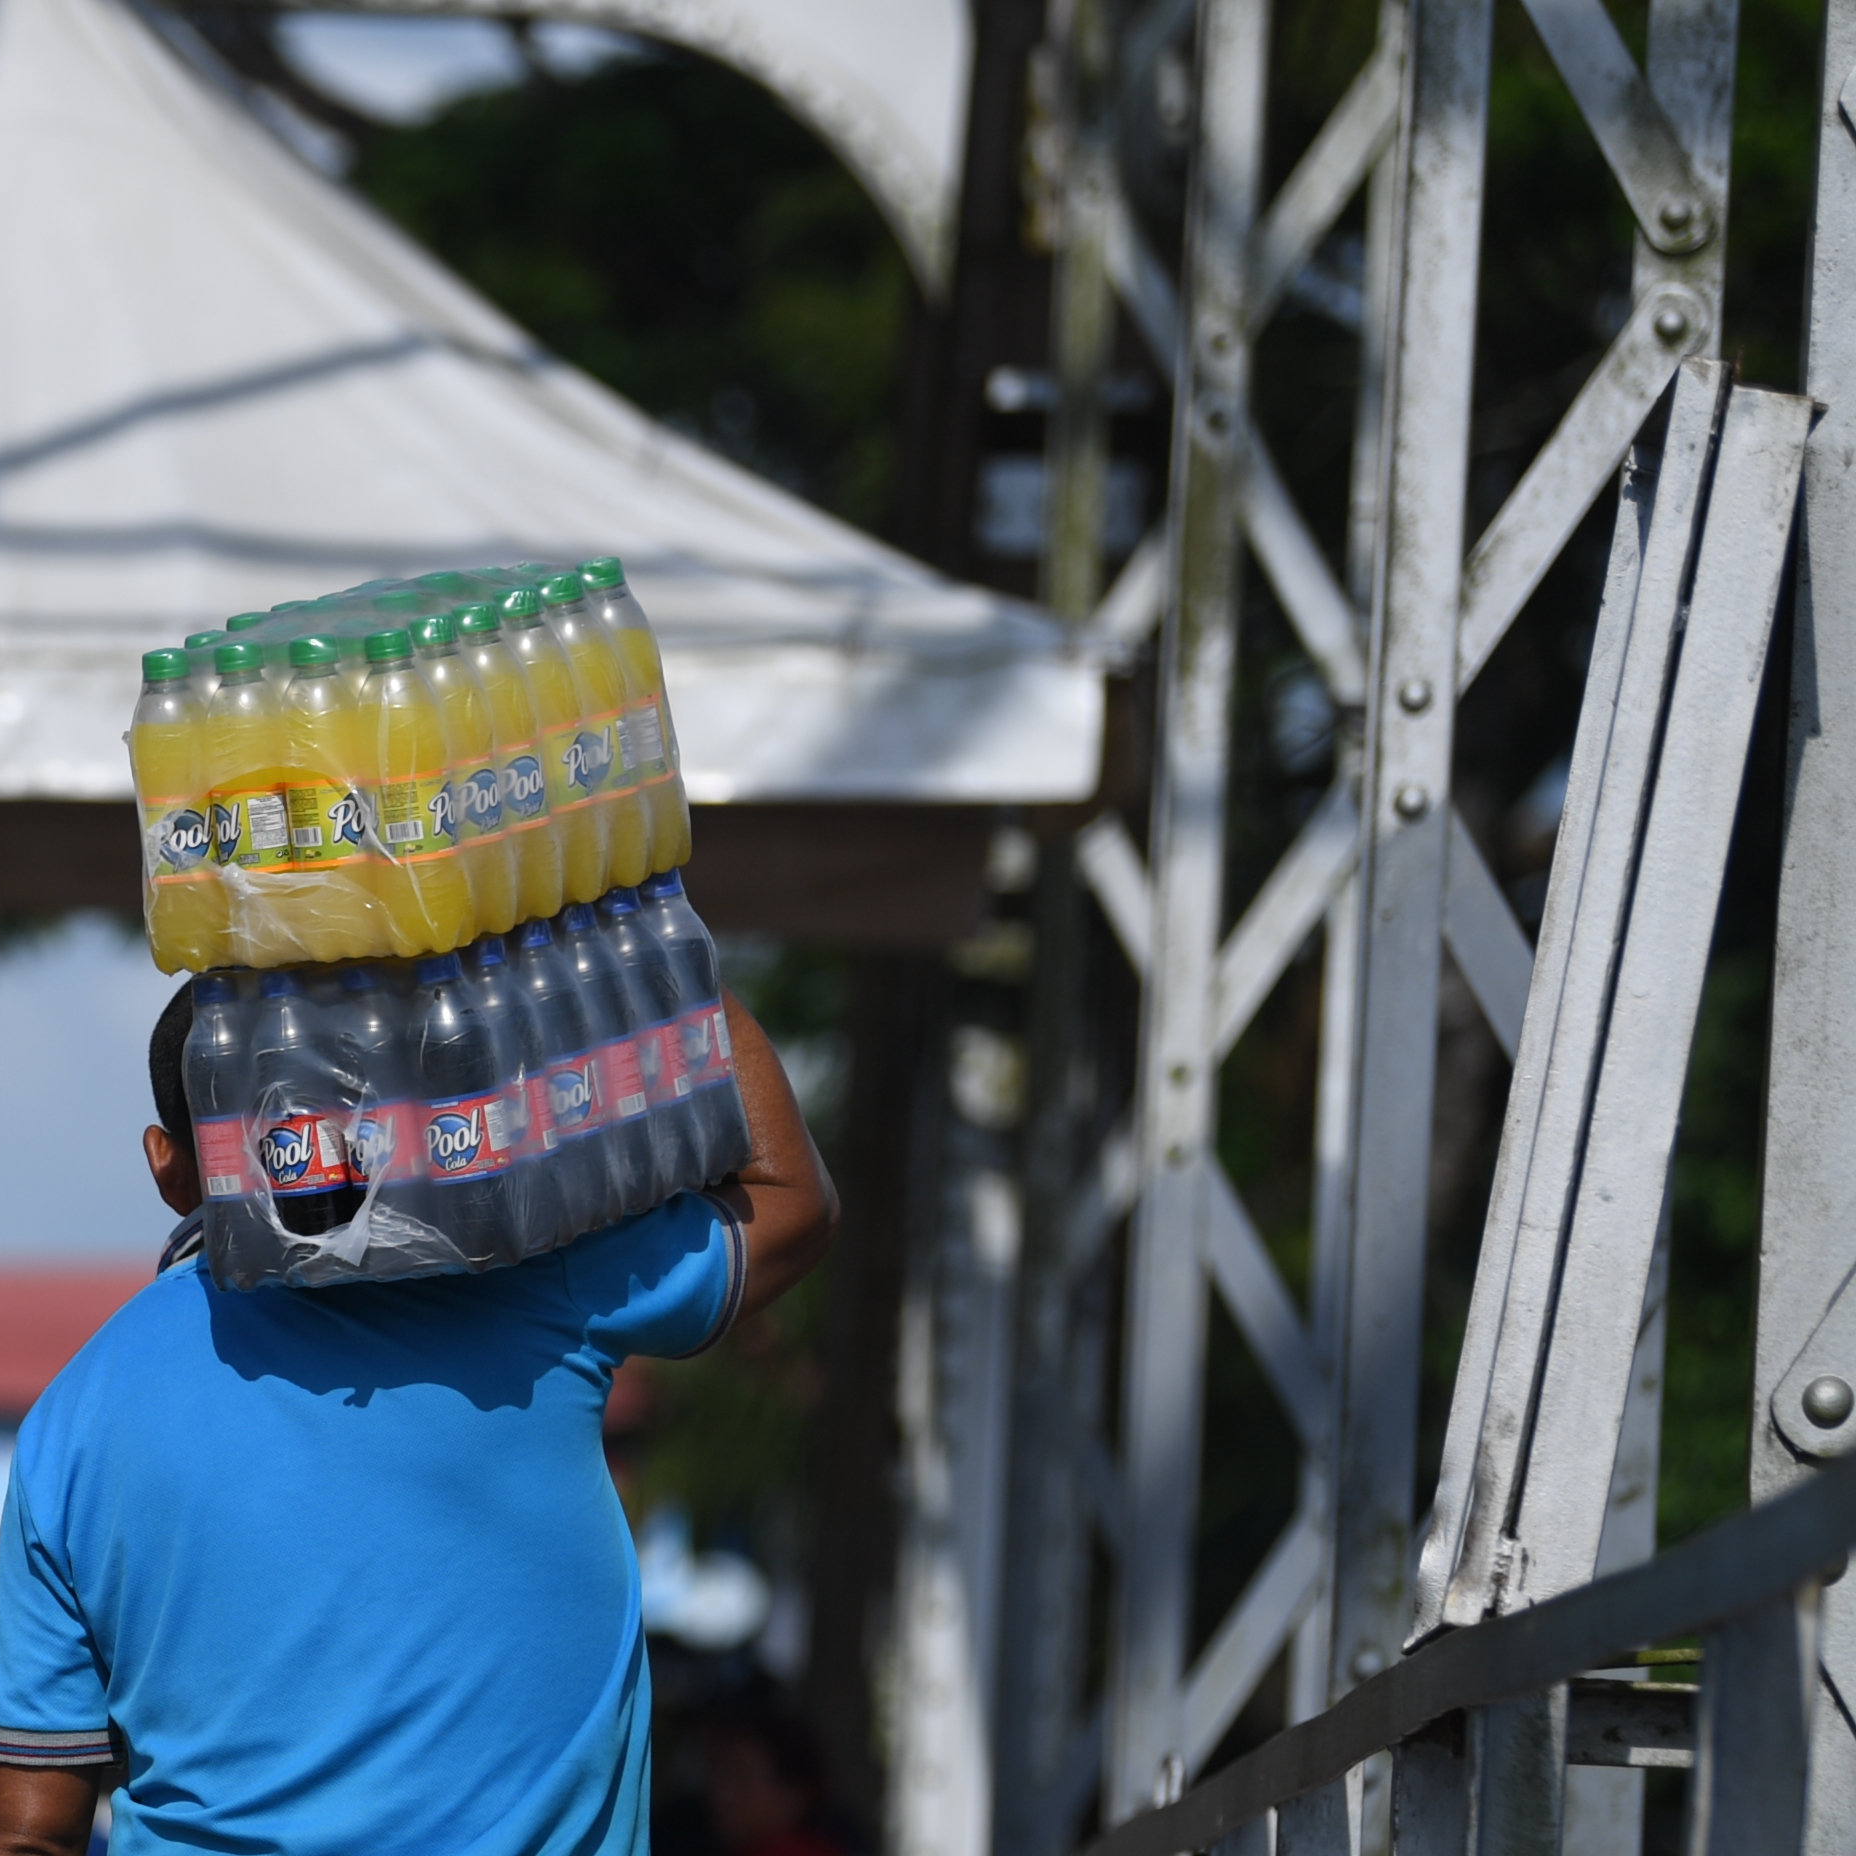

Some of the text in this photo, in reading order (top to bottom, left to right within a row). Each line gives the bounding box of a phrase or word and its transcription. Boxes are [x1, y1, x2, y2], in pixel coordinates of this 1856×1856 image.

[563, 726, 611, 787] Pool
[457, 780, 500, 827] Poo
[263, 1123, 312, 1175] Pool
[425, 1108, 481, 1163] Pool
[278, 1169, 297, 1184] Cola
[445, 1156, 467, 1171] Cola
